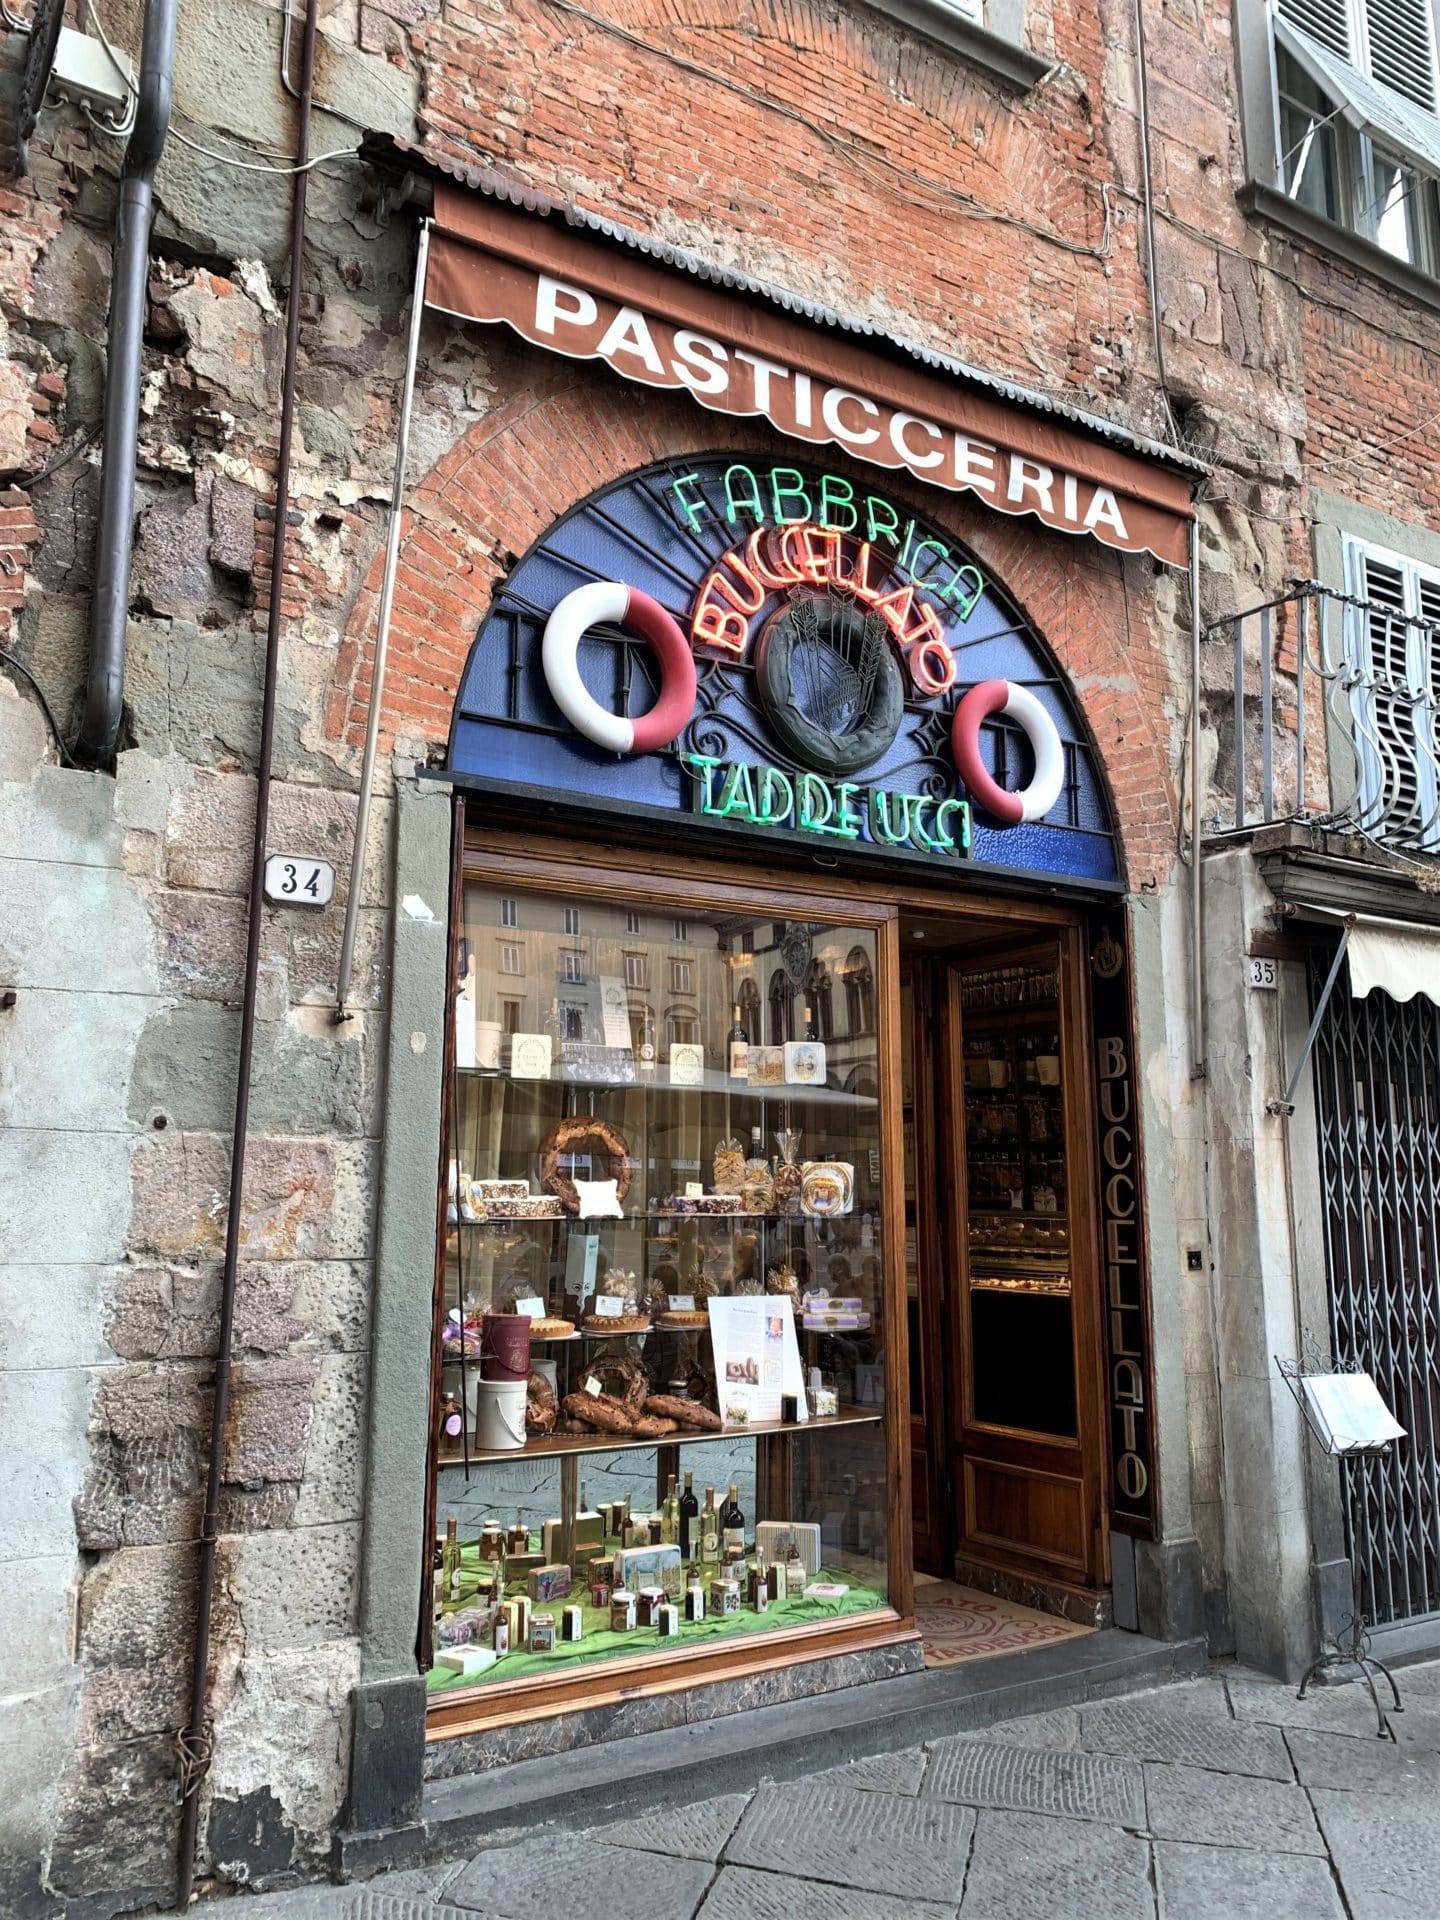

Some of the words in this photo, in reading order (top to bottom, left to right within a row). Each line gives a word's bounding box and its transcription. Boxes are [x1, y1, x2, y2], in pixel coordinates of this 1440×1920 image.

[534, 273, 1130, 540] PASTICCERIA
[672, 464, 985, 621] FABBRICA
[692, 522, 957, 692] BUCCELLATO
[690, 754, 972, 851] TADDEUCCI
[281, 864, 321, 897] 34
[1254, 961, 1275, 984] 35
[1098, 1036, 1148, 1499] BUCCELLATO
[924, 1624, 1075, 1661] TADDEUCCI
